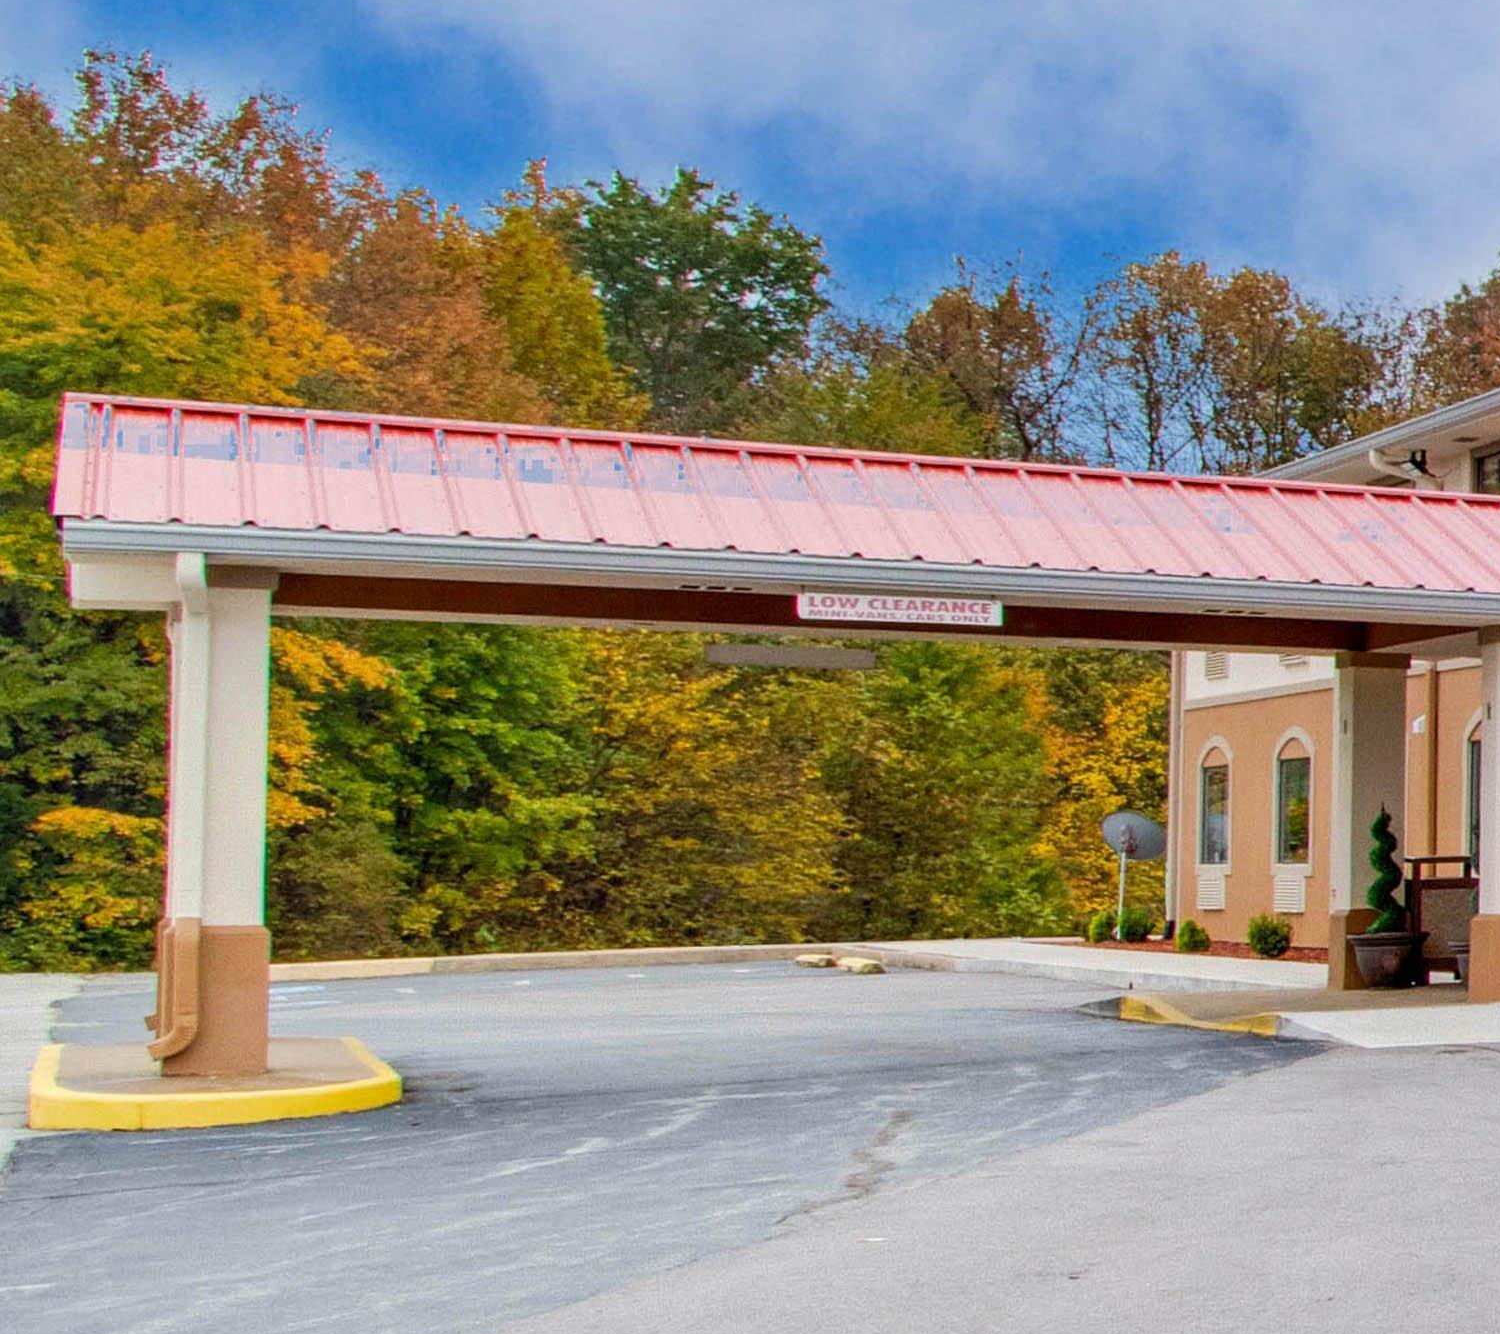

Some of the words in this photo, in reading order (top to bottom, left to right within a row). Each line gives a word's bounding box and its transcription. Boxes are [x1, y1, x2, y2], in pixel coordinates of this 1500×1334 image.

[808, 595, 860, 609] LOW
[867, 598, 992, 615] CLEARANCE
[951, 614, 990, 624] ONLY
